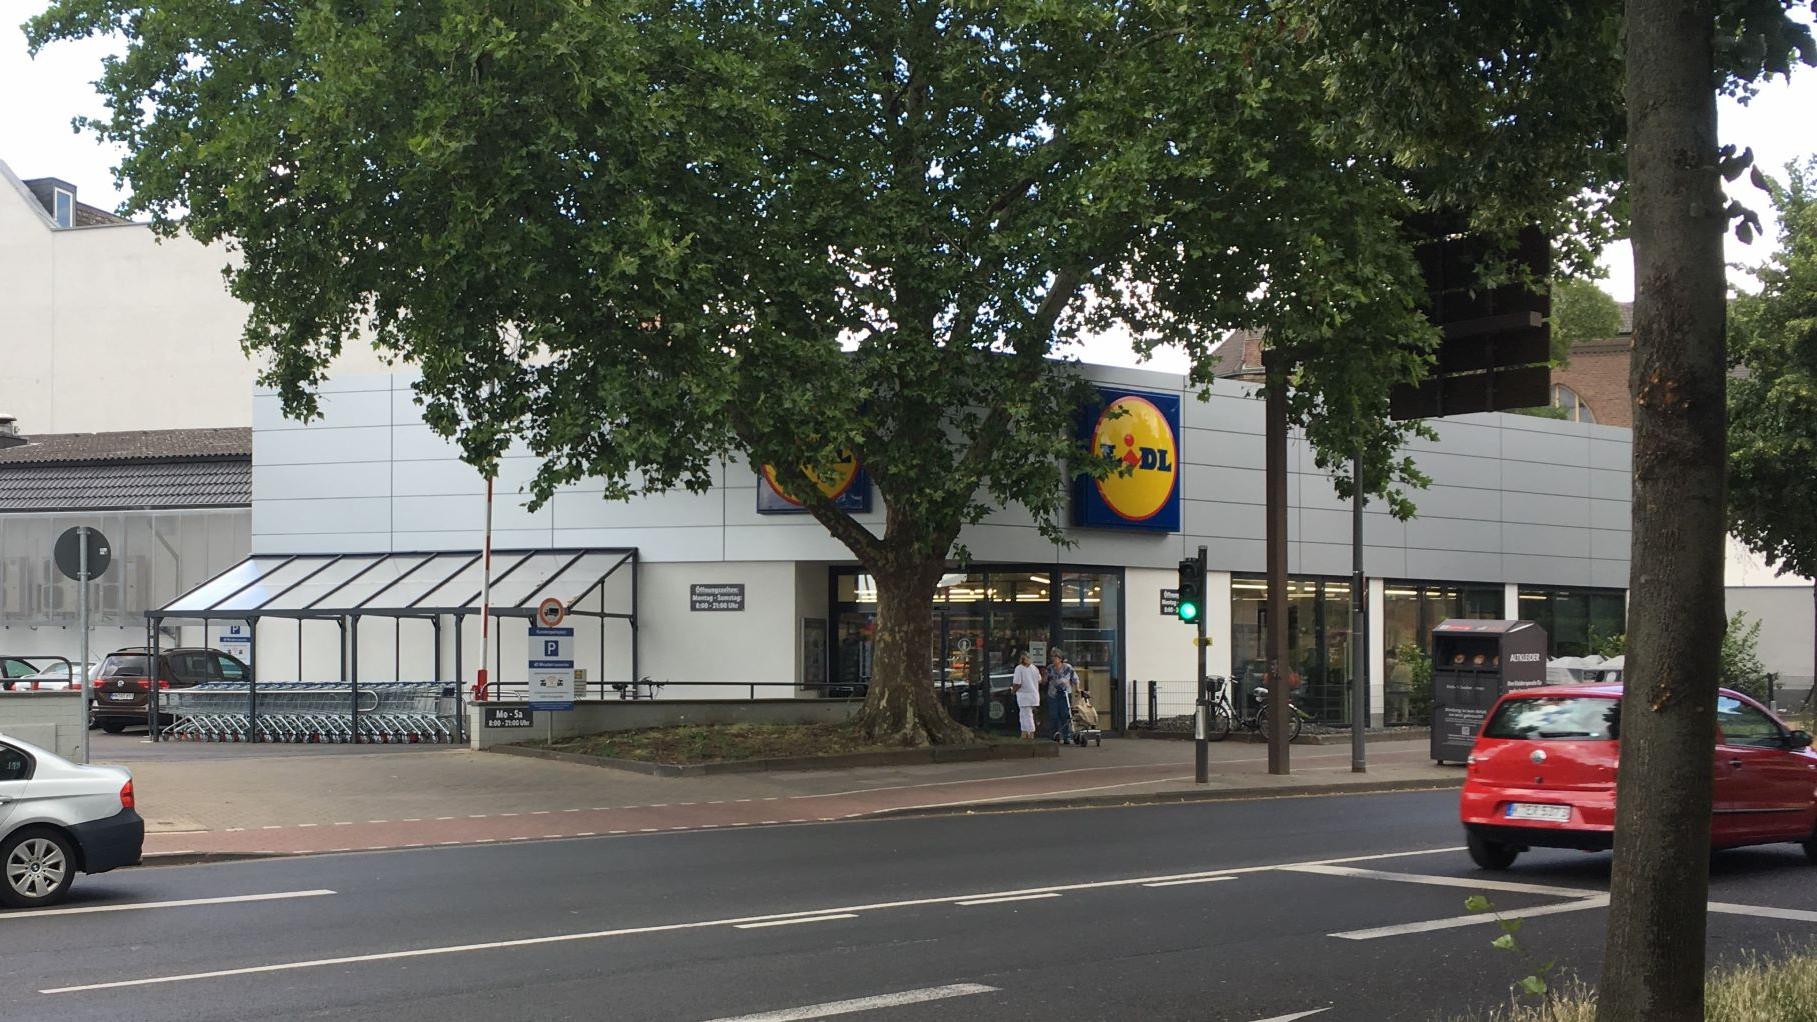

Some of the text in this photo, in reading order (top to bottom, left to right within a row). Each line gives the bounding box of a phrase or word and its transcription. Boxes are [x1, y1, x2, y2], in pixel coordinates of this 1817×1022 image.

[692, 594, 713, 602] Montag
[547, 642, 556, 655] P
[1509, 653, 1540, 662] ALTKLEIDER
[496, 710, 508, 718] Mo
[514, 709, 523, 718] Sa
